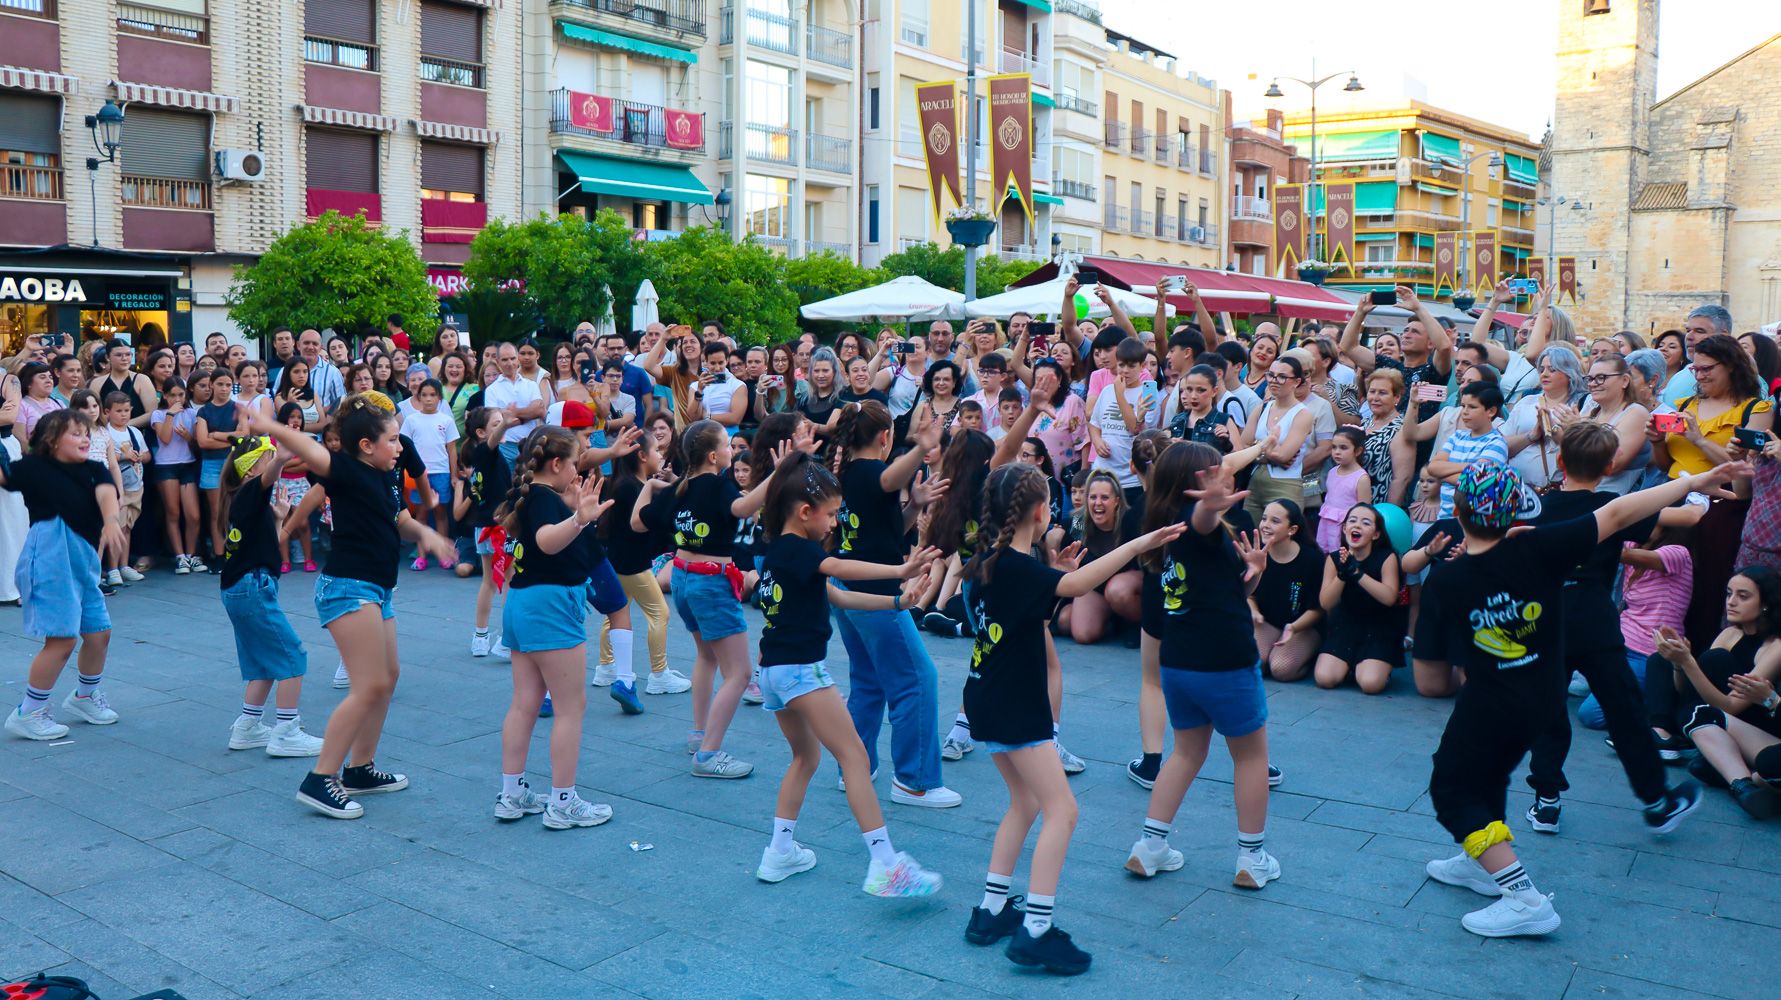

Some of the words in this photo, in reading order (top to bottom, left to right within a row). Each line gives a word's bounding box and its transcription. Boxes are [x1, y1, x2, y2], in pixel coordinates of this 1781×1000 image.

[921, 99, 954, 111] ARACELI
[1328, 192, 1353, 200] ARACELI
[1469, 599, 1524, 631] Street
[560, 792, 569, 801] C
